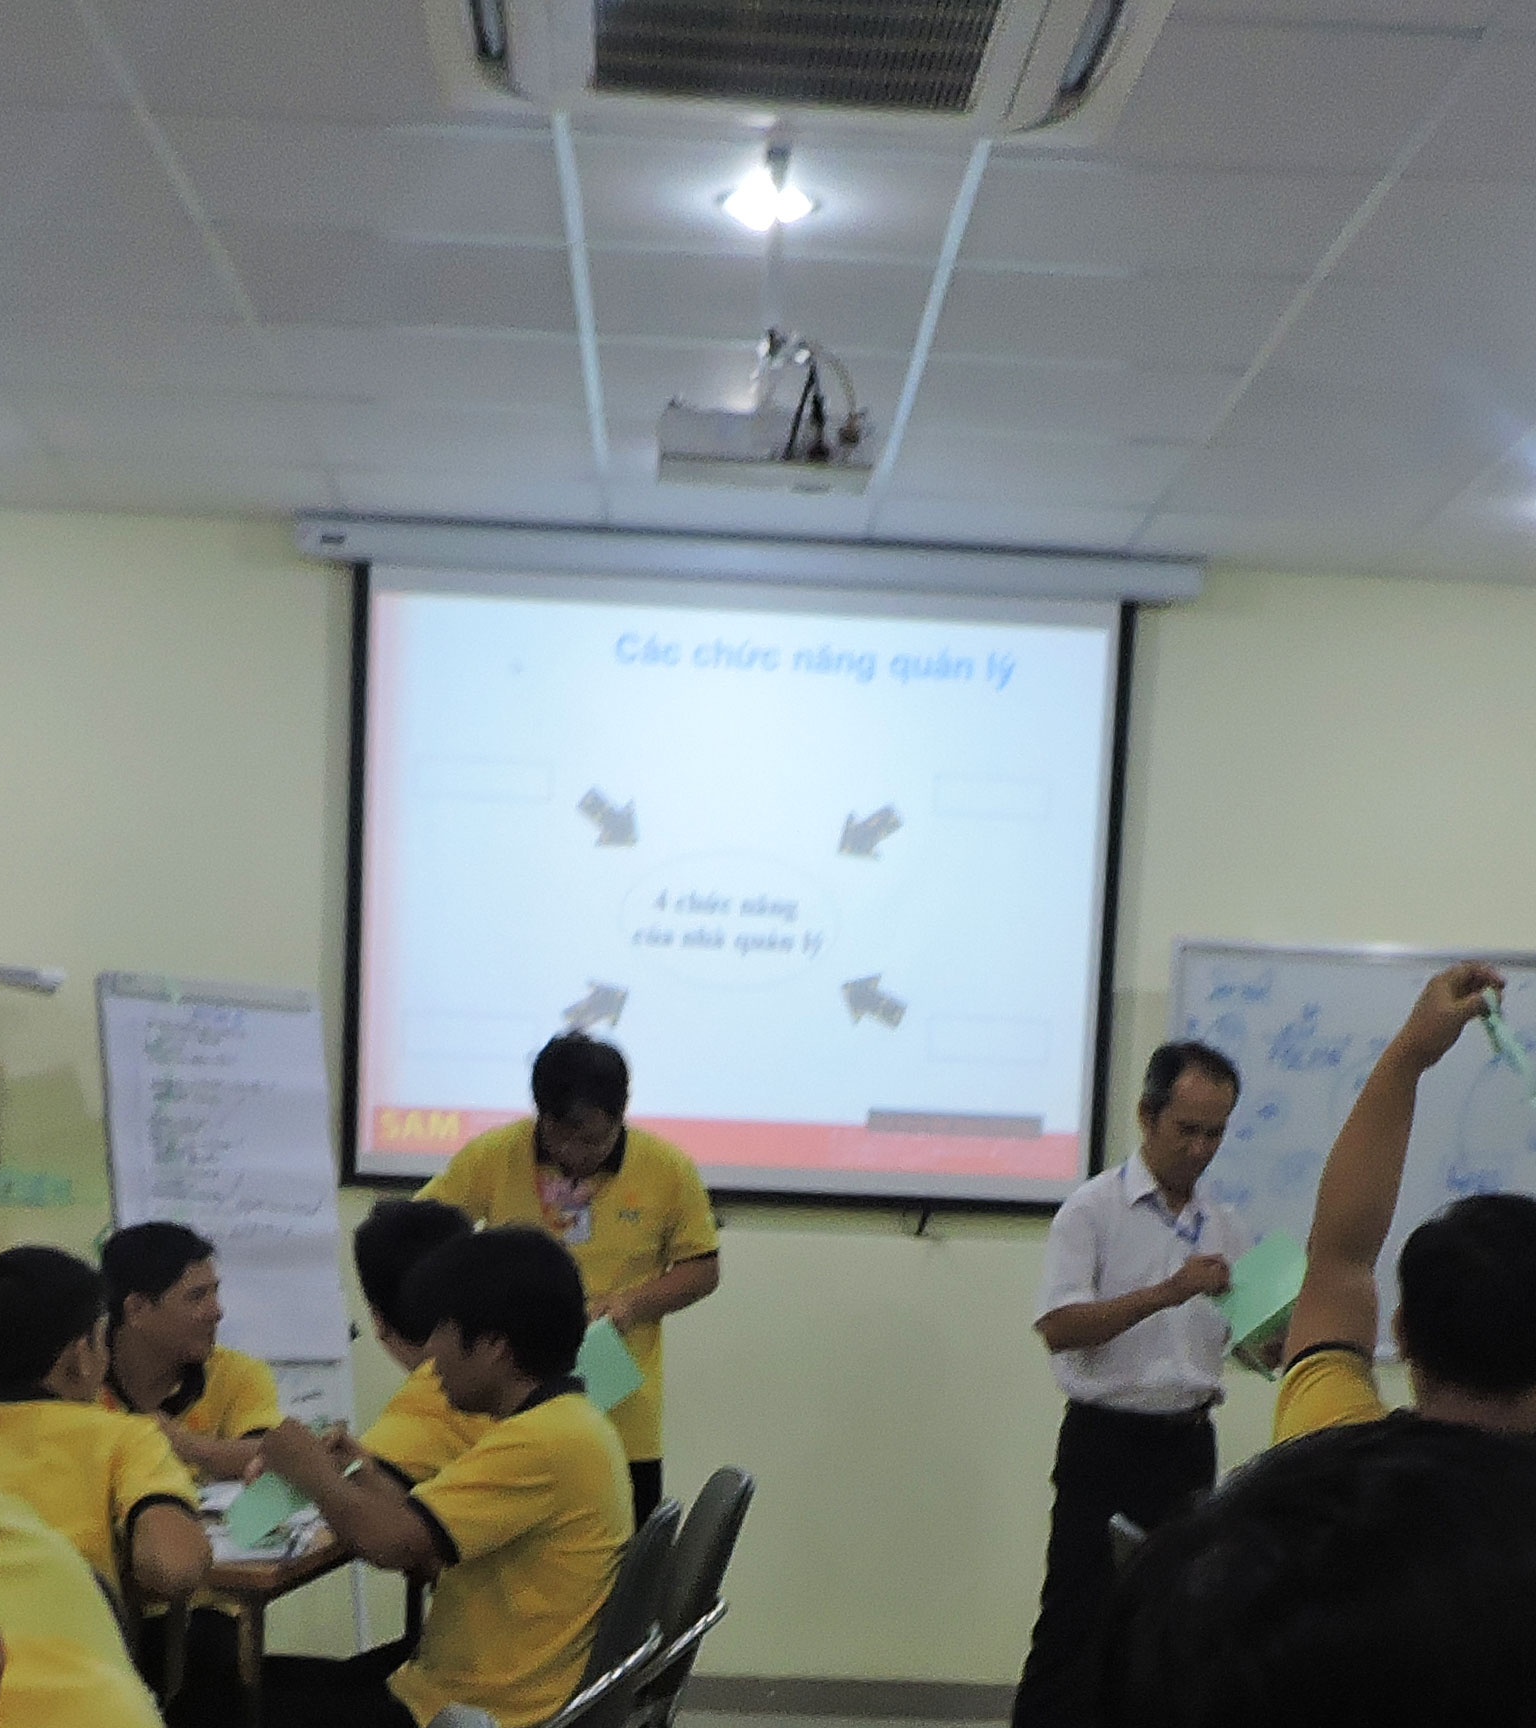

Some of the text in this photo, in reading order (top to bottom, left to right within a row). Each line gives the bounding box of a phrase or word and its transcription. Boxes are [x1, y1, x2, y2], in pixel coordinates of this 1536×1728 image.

[615, 631, 681, 667] Các
[986, 648, 1017, 693] lý
[380, 1108, 461, 1141] SAM
